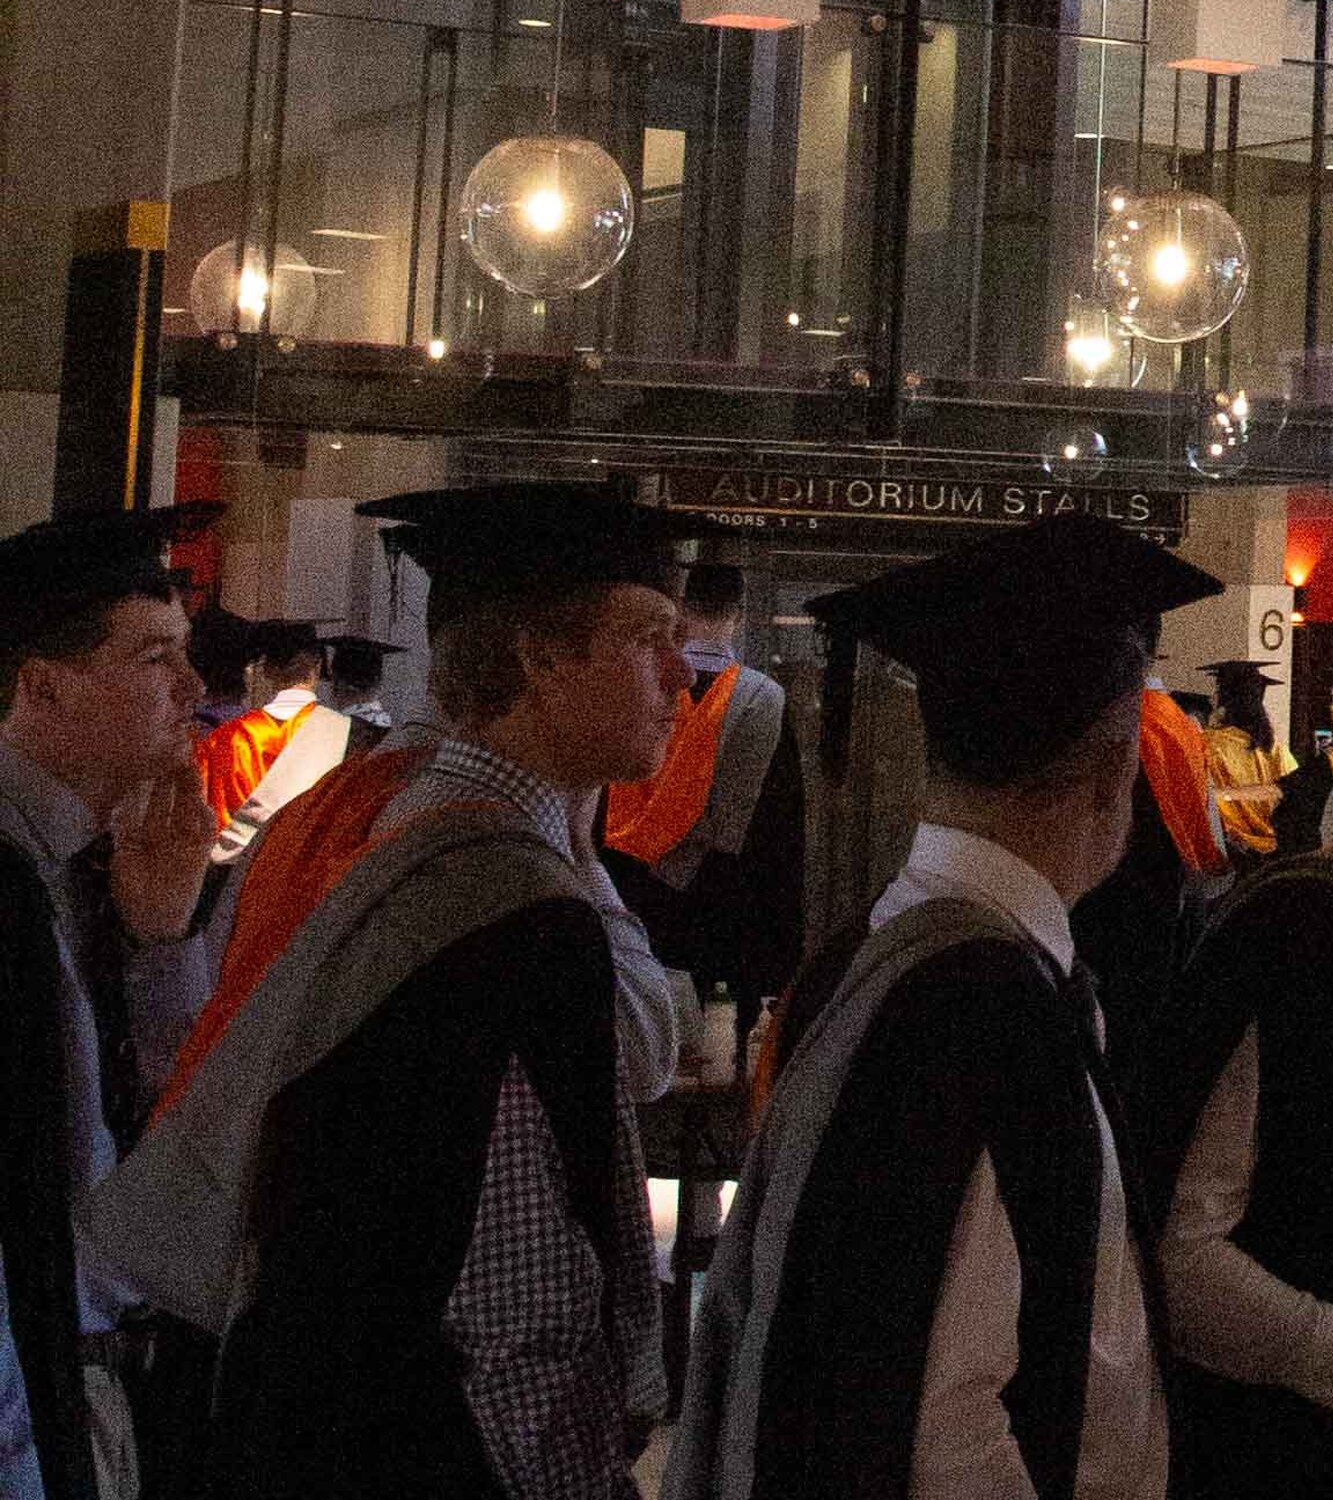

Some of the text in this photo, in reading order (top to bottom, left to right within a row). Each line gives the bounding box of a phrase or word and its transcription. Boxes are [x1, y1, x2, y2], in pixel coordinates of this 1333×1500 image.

[710, 474, 1151, 522] AUDITORIUM STALLS
[1260, 608, 1284, 652] 6
